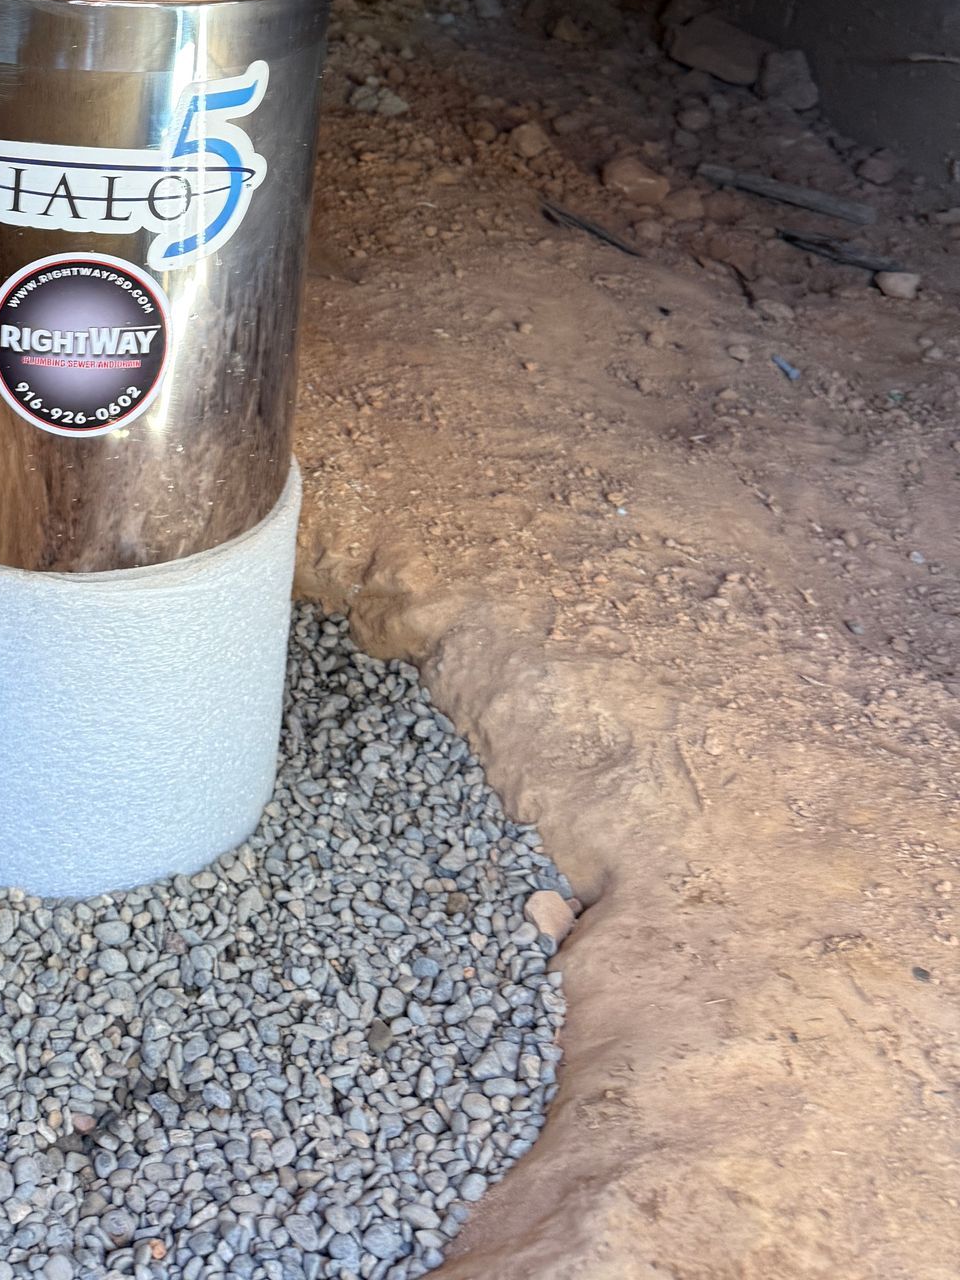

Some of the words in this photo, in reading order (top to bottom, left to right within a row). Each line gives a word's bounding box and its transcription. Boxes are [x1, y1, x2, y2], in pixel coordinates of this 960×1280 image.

[162, 79, 259, 259] 5
[7, 267, 155, 315] WWW.RIGHTWAYPSD.COM
[67, 359, 96, 369] SEWER
[15, 381, 142, 425] 916-926-0602
